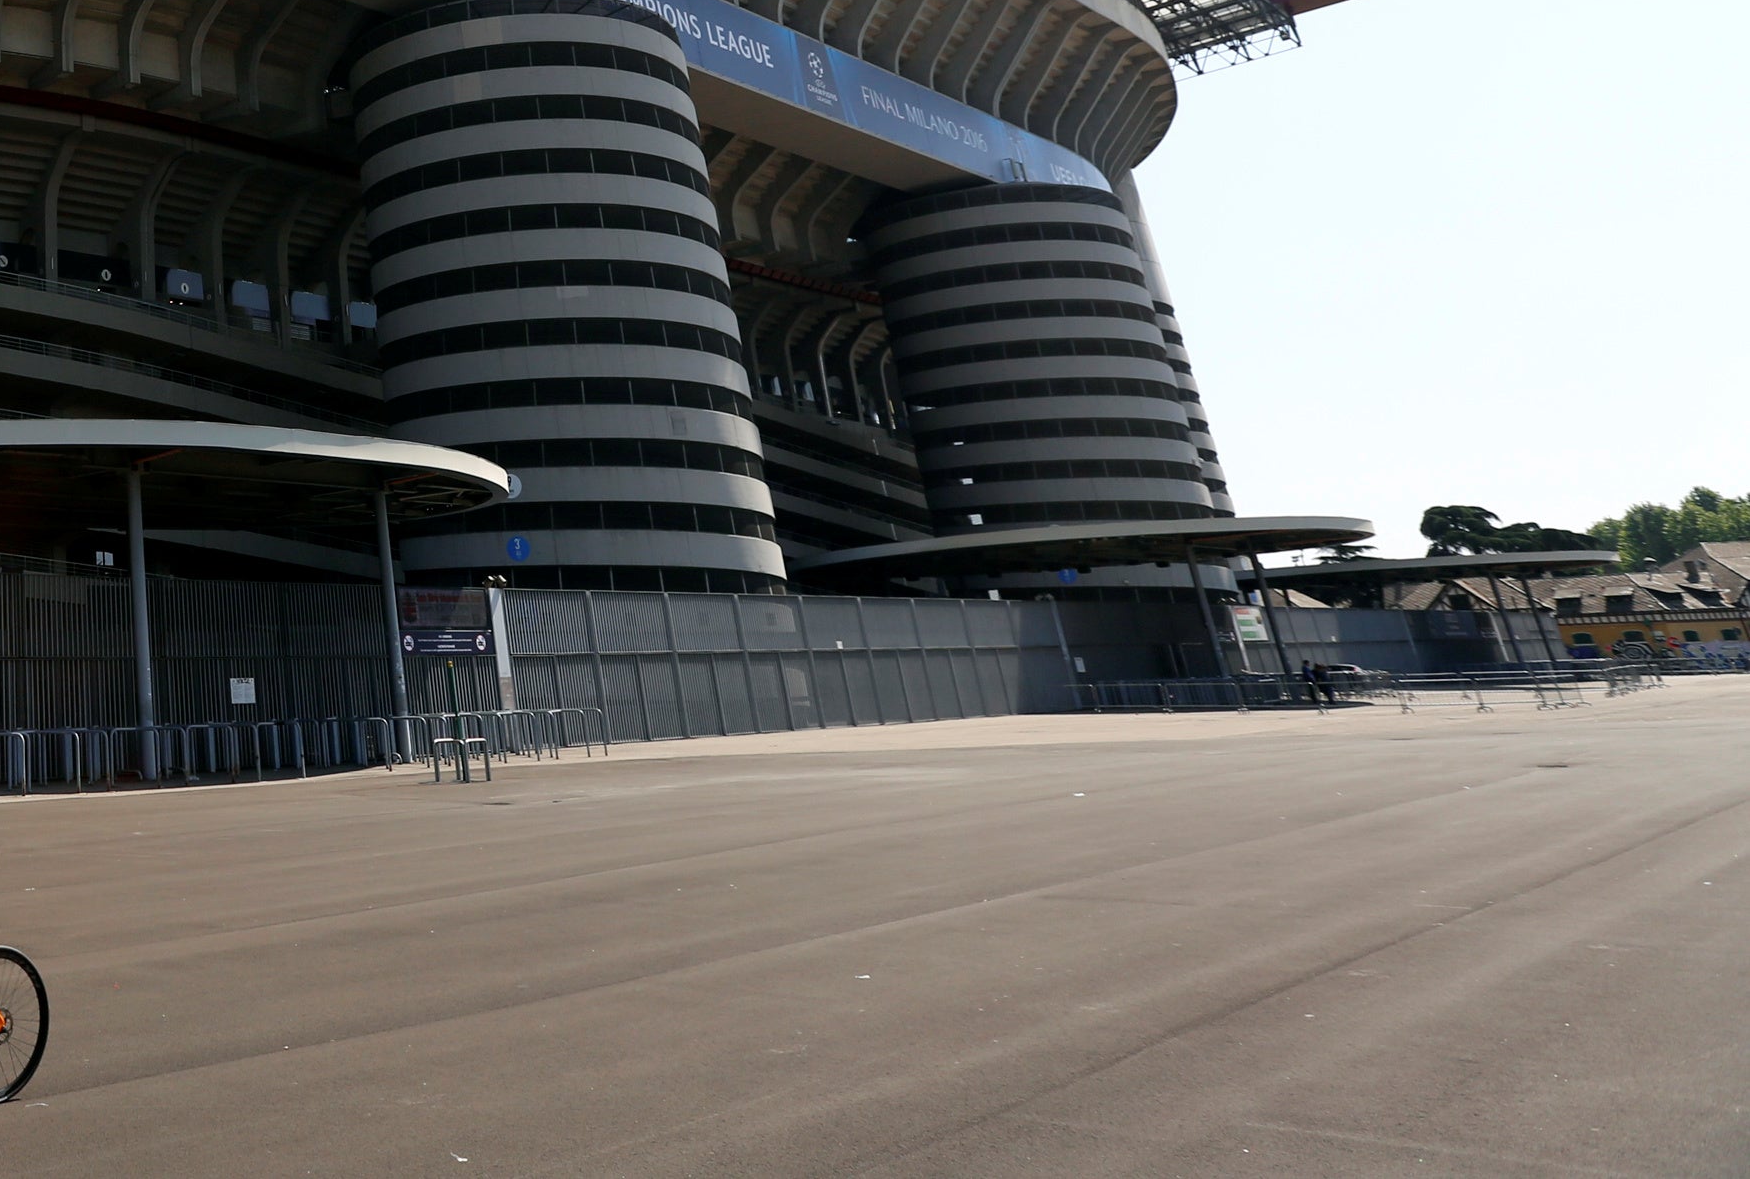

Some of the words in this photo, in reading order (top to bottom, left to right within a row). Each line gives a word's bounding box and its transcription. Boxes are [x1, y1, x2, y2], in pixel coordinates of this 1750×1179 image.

[705, 21, 774, 69] LEAGUE
[860, 85, 905, 120] FINAL
[904, 103, 960, 141] MILANO
[959, 125, 988, 153] 2016
